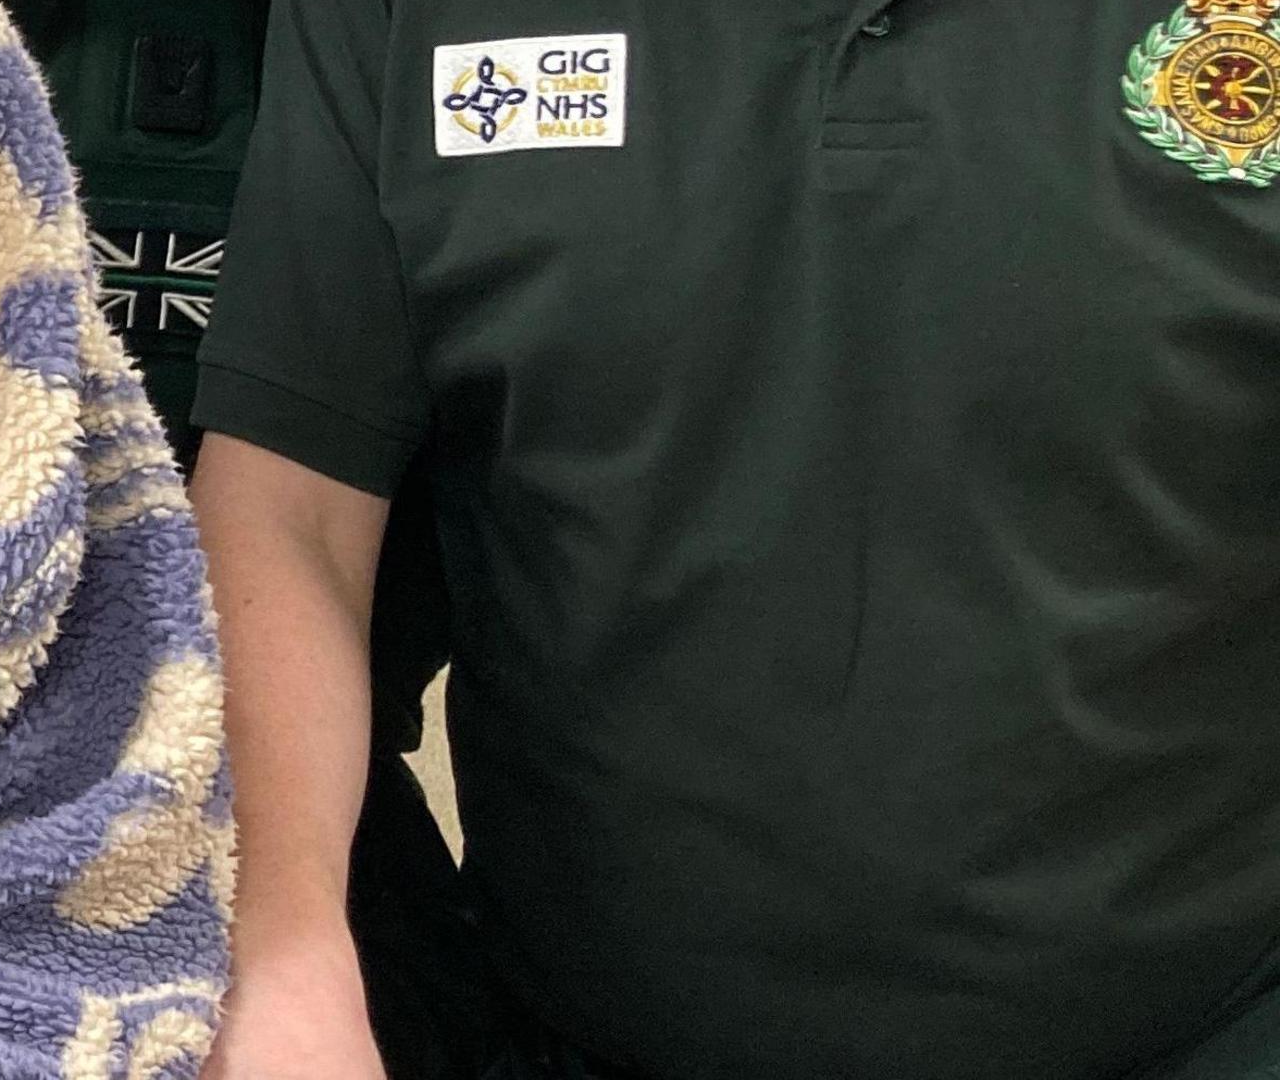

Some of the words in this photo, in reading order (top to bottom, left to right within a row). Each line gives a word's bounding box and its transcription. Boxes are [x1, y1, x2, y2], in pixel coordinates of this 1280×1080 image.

[538, 48, 610, 75] GIG
[536, 74, 608, 93] CYMRU
[536, 93, 608, 121] NHS
[536, 119, 606, 137] WALES
